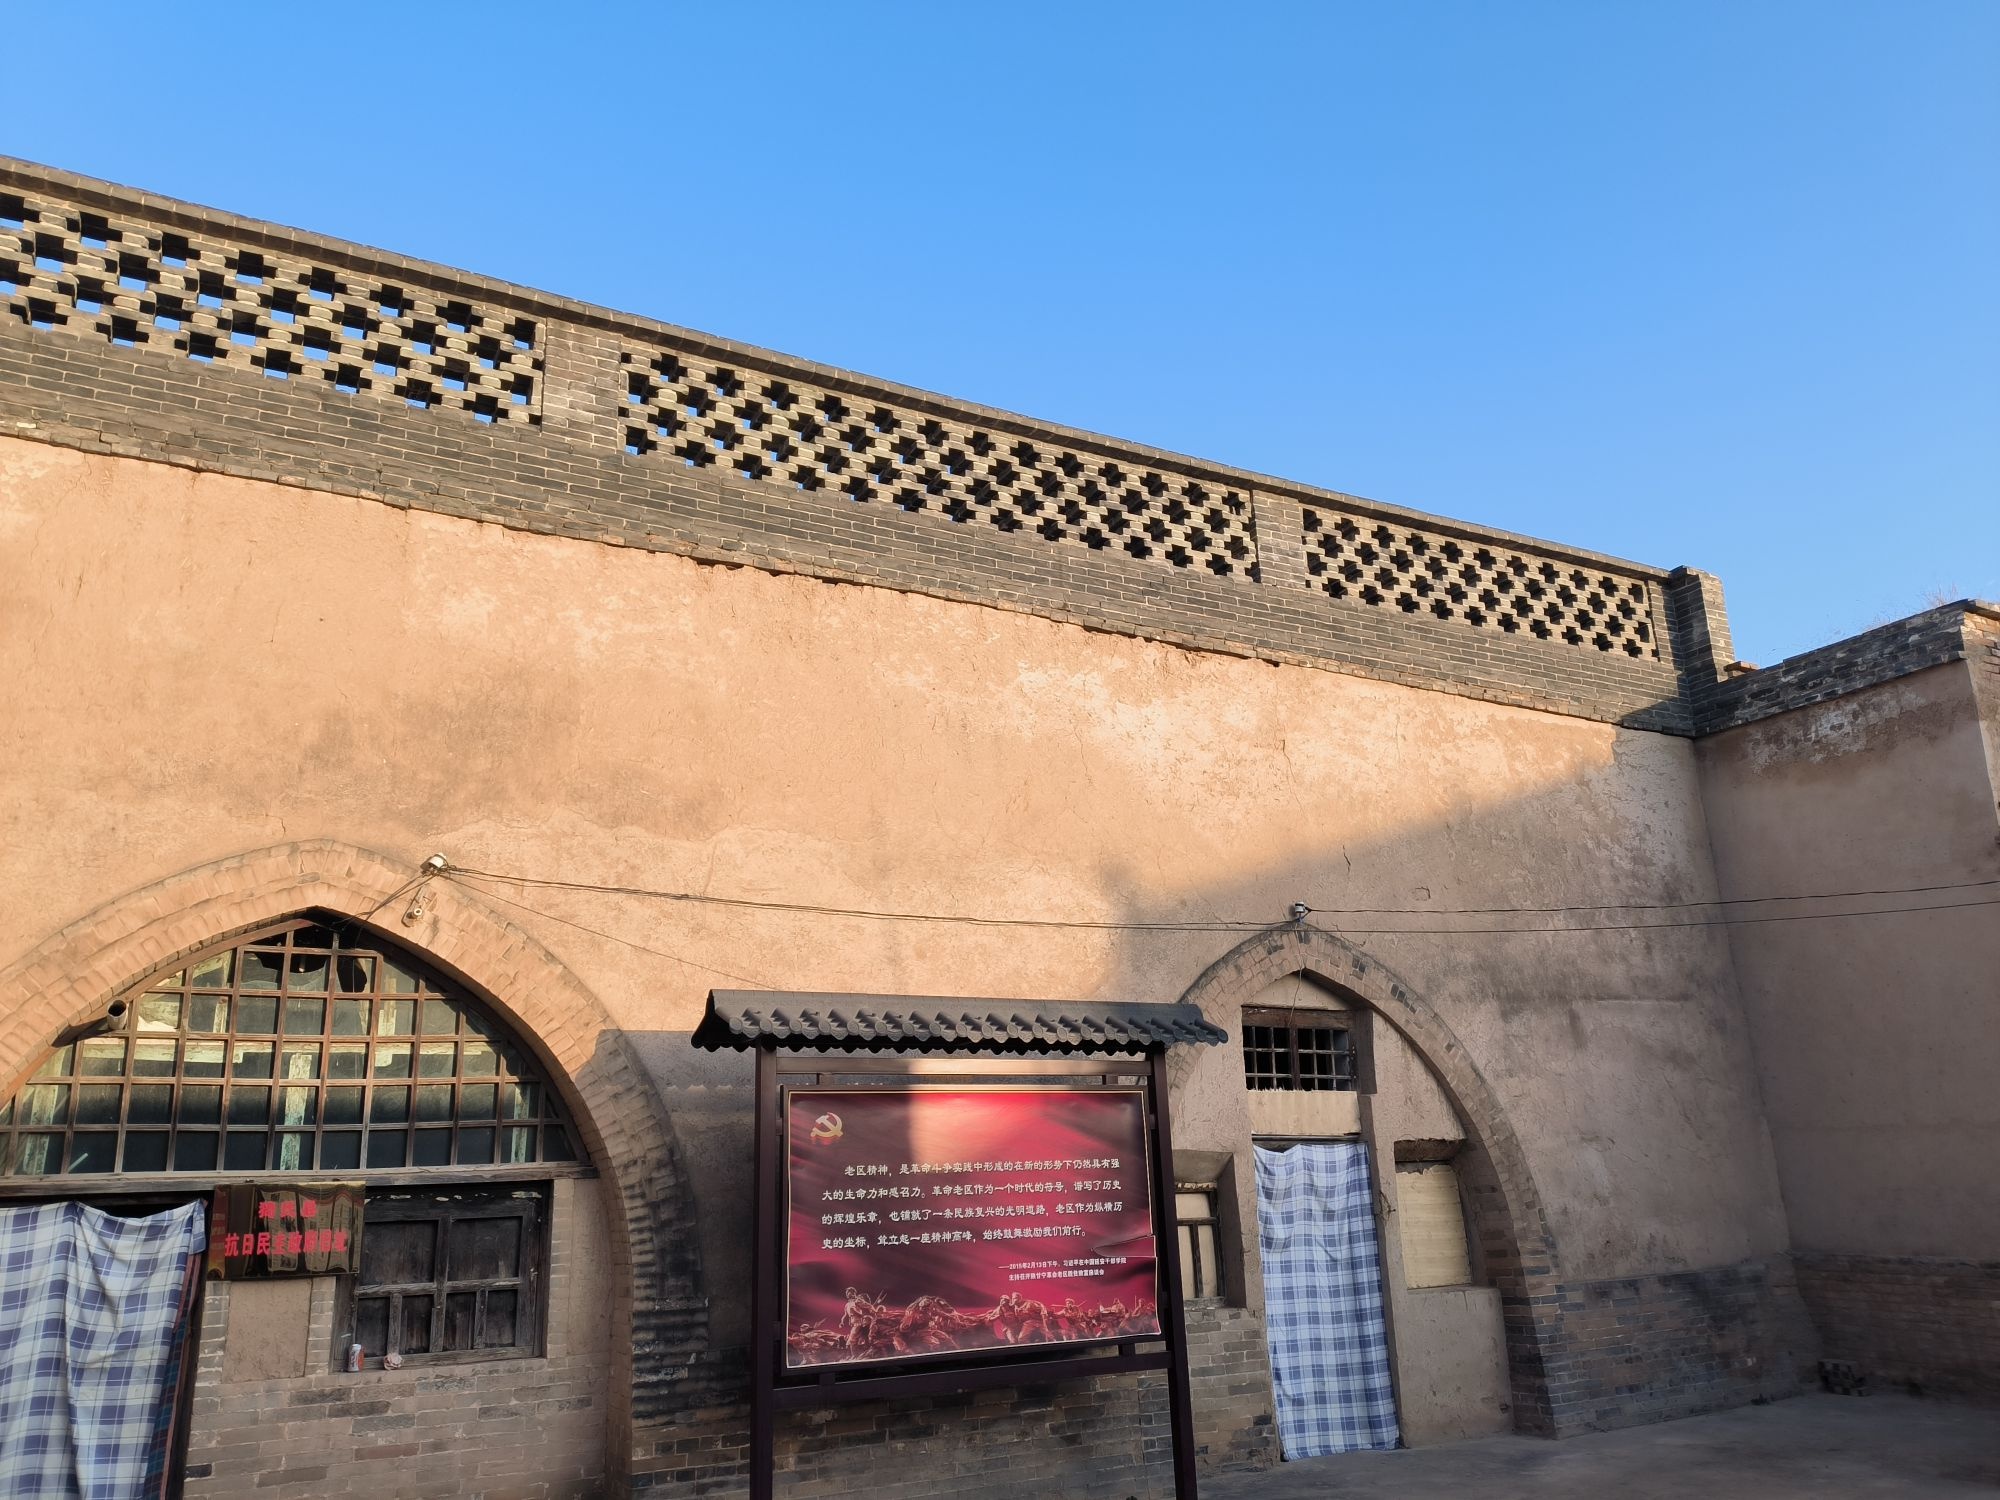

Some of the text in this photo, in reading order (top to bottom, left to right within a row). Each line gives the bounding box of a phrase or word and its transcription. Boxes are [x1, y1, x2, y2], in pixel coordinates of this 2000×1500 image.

[224, 1228, 347, 1256] 抗日民主政府旧址
